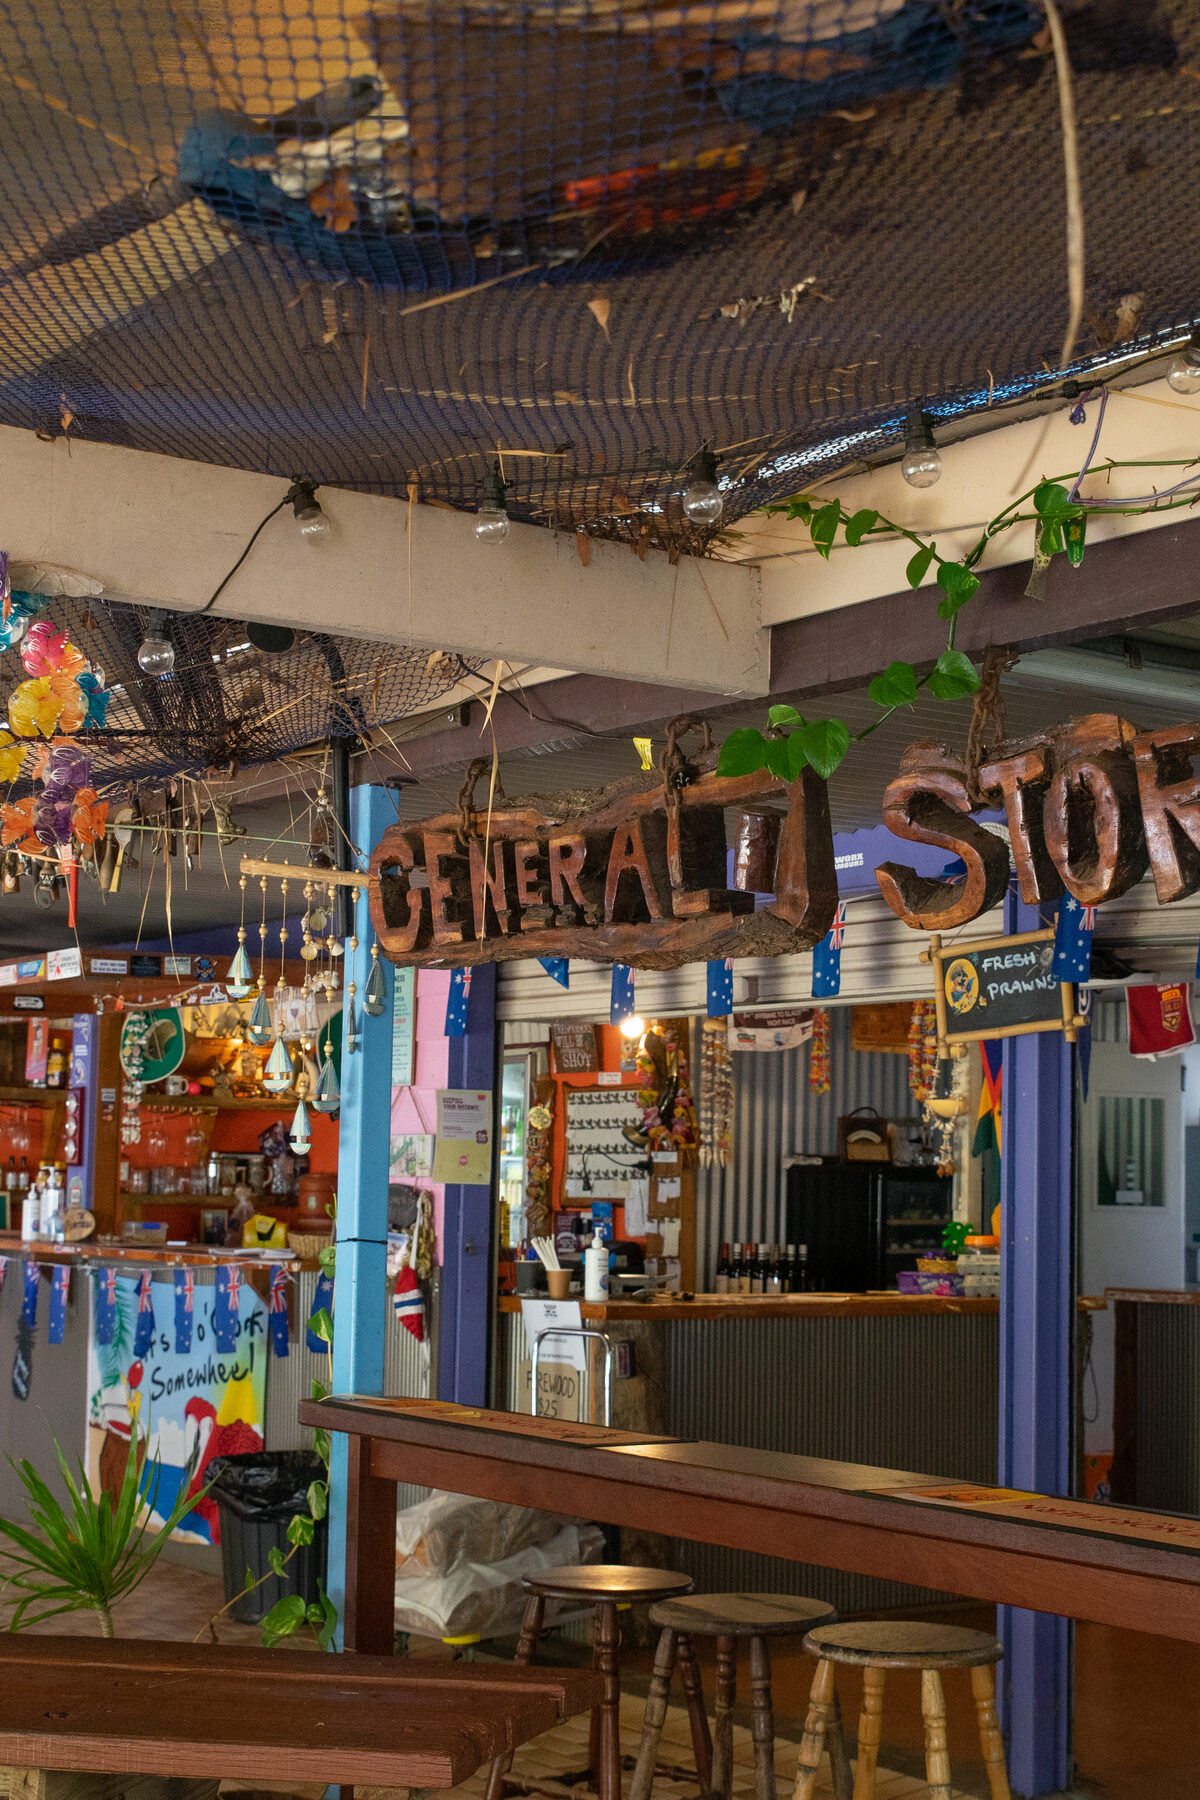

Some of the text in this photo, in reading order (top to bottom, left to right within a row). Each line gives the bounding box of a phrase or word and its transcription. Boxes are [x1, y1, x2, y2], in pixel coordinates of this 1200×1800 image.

[368, 803, 711, 953] GENERAL
[981, 951, 1037, 973] FRESH
[987, 973, 1057, 1000] PRAWNS
[562, 1052, 592, 1068] SHOT
[526, 1370, 576, 1399] FREWOOD
